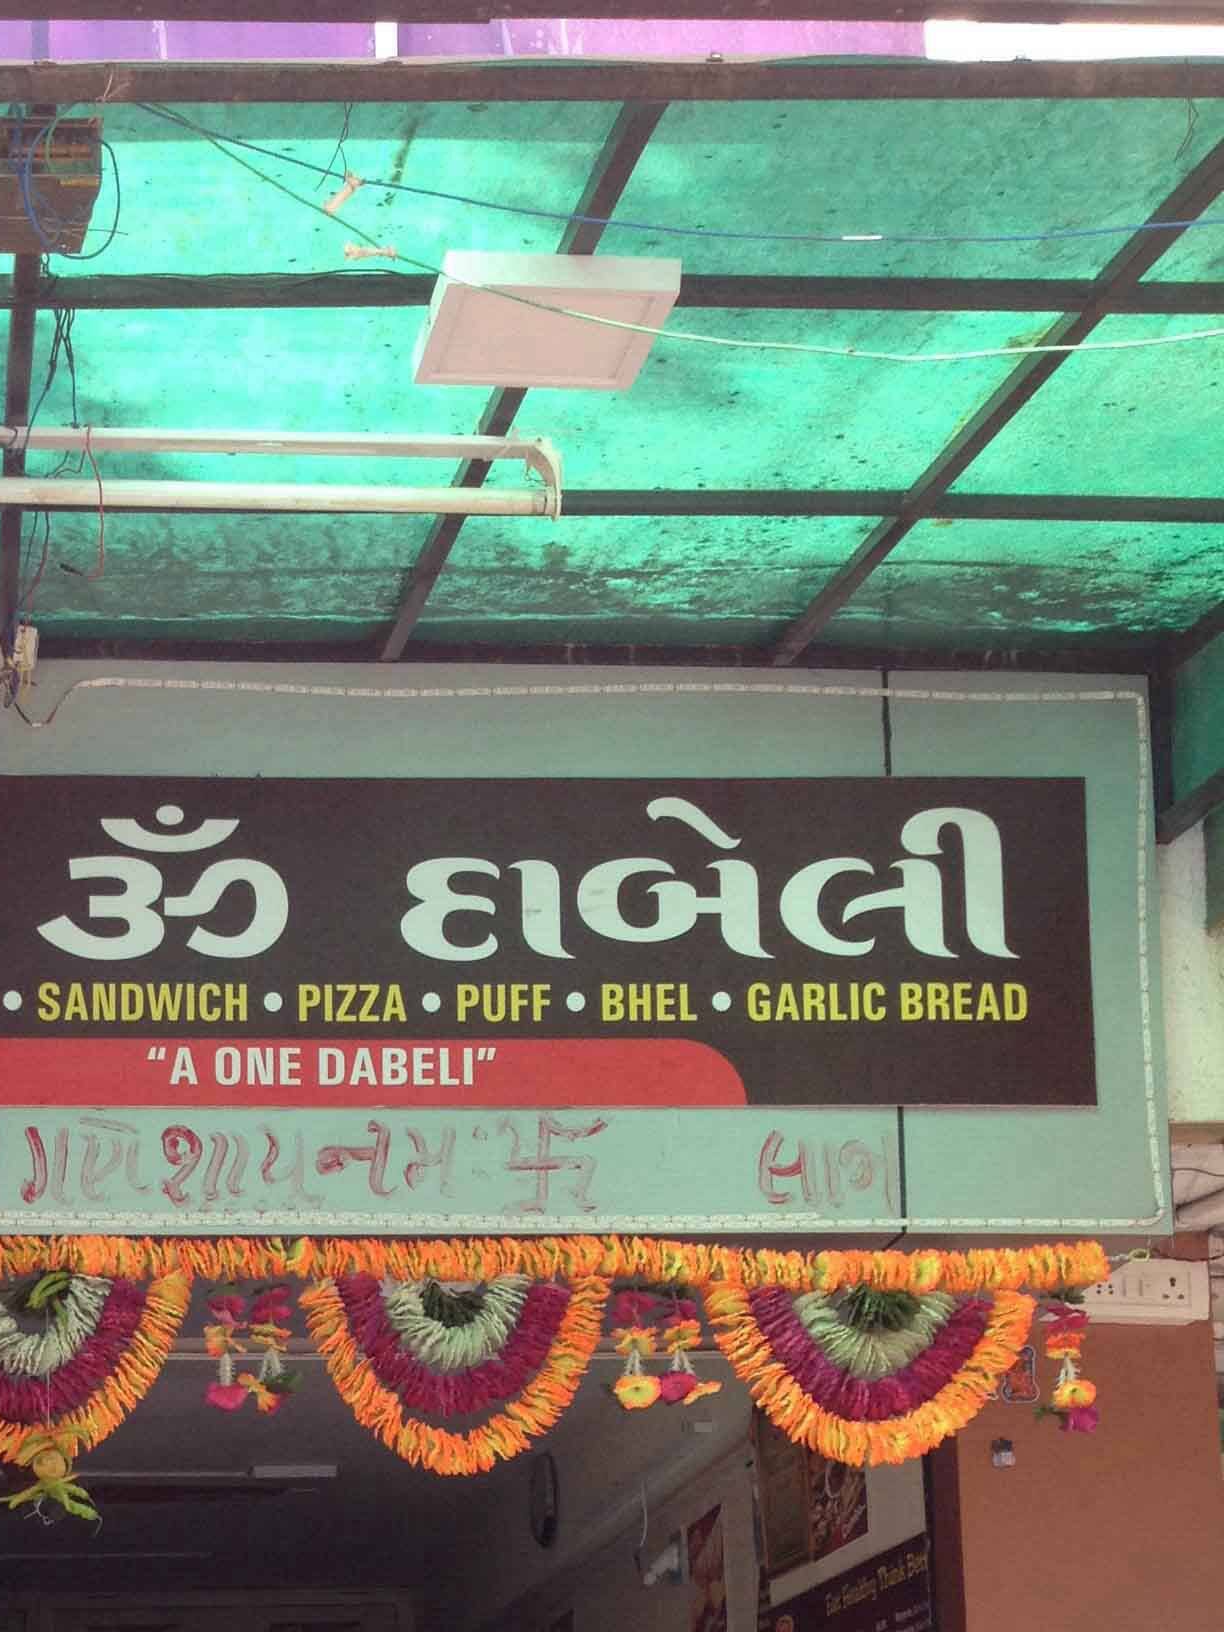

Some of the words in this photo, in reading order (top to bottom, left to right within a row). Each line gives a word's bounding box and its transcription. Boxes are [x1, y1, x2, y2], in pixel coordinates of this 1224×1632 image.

[399, 796, 1021, 962] દાબેલી
[37, 982, 250, 1023] SANDWICH
[297, 982, 408, 1023] PIZZA
[456, 983, 552, 1022] PUFF
[600, 982, 699, 1022] BHEL
[746, 982, 888, 1022] GARLIC
[899, 982, 1030, 1022] BREAD
[214, 1046, 303, 1087] ONE
